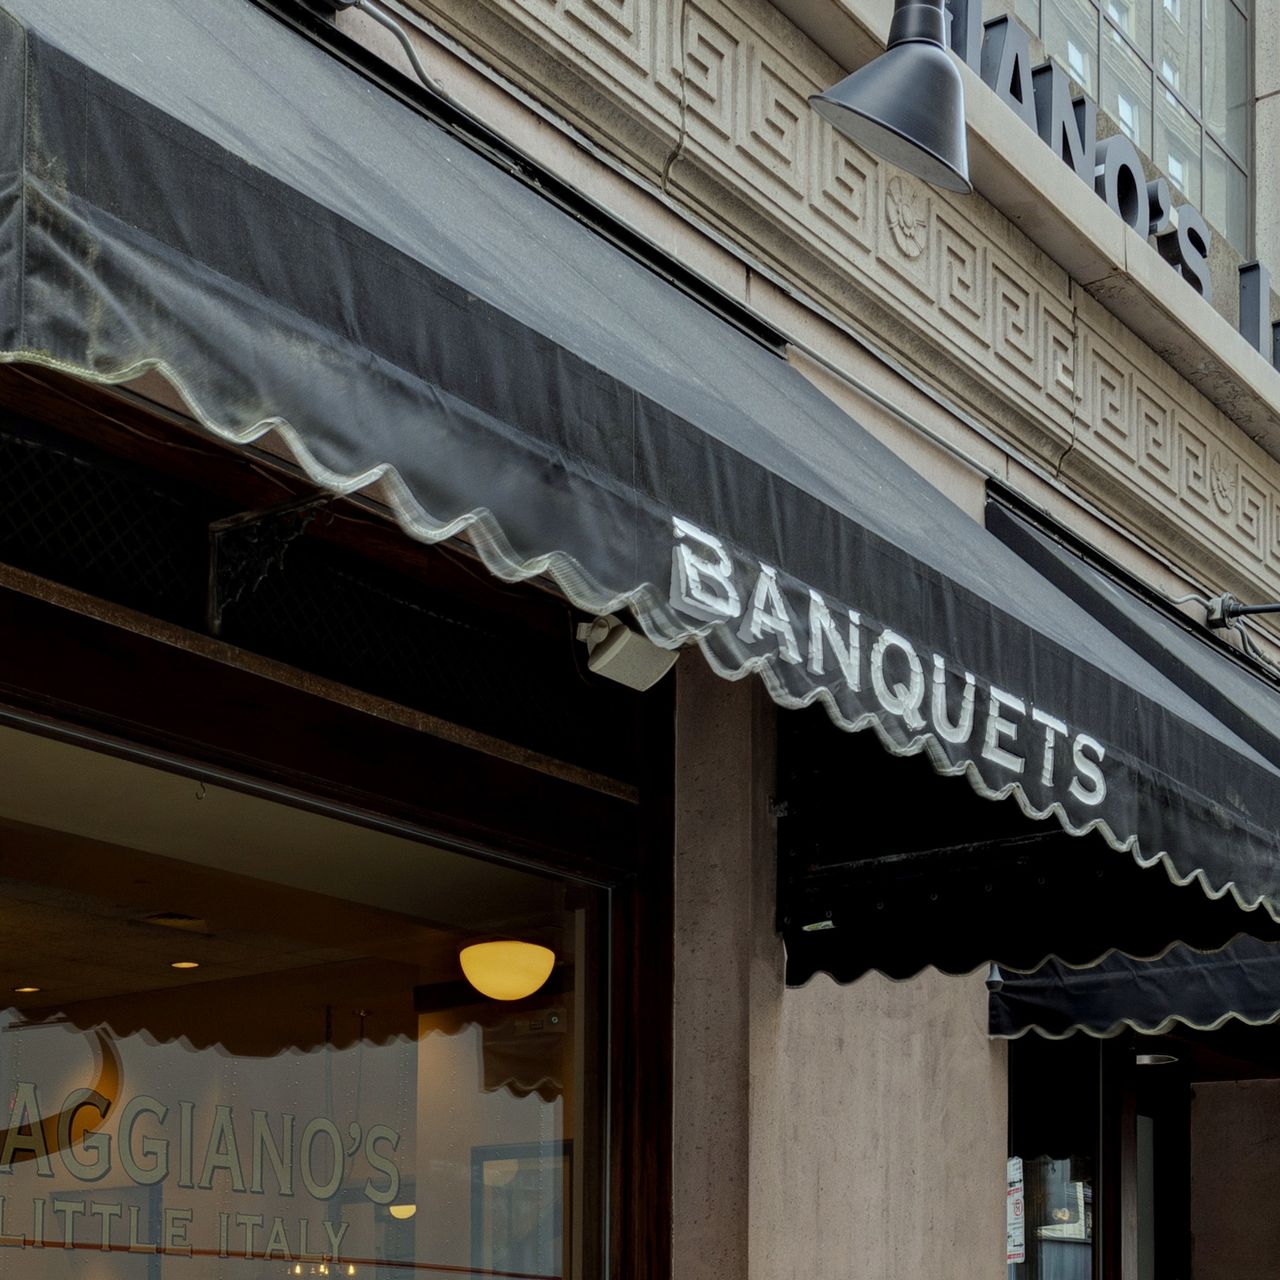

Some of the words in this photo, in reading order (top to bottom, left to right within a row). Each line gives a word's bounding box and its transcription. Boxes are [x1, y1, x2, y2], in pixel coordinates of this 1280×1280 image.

[945, 0, 1212, 300] IANO'S
[670, 516, 1107, 806] BANQUETS
[218, 1211, 350, 1264] ITALY
